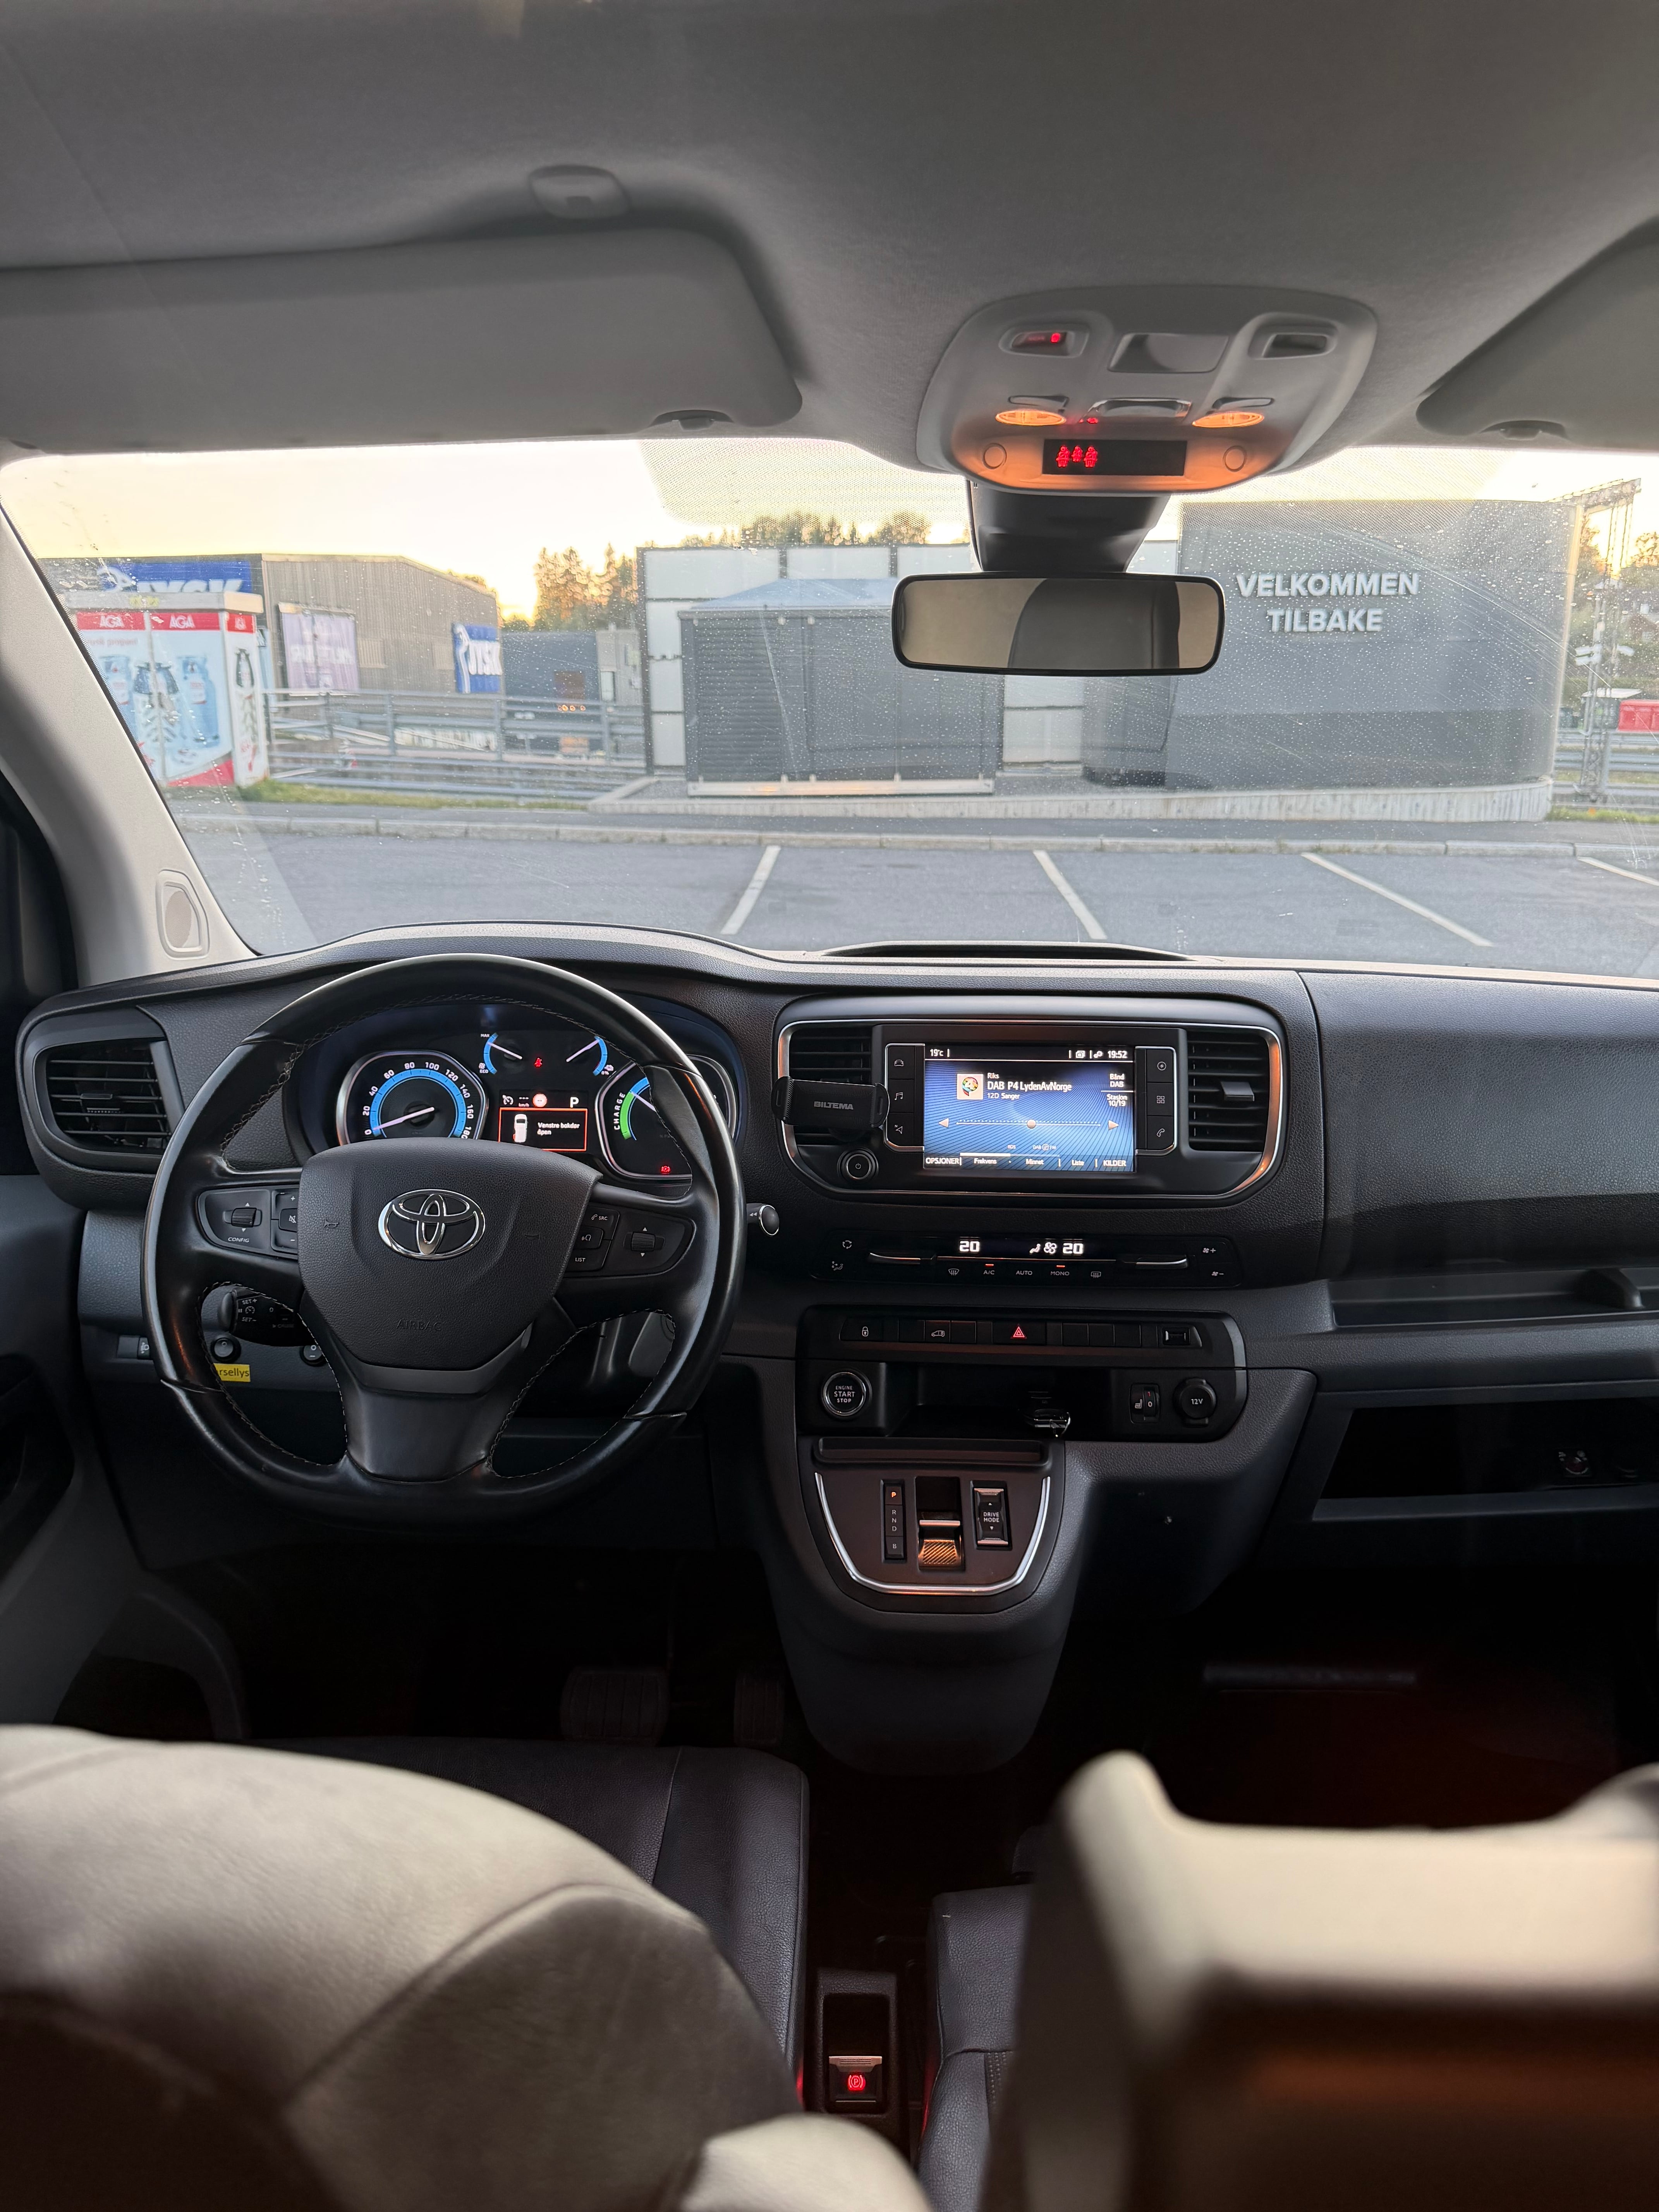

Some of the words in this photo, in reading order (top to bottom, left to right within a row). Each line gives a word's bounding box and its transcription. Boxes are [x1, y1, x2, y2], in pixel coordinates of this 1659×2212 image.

[1237, 572, 1419, 596] VELKOMMEN
[99, 615, 125, 628] AGA
[169, 614, 195, 629] AGA
[1267, 608, 1382, 632] TILBAKE
[1108, 1050, 1128, 1058] 19:52
[425, 1062, 440, 1070] 100
[383, 1069, 394, 1079] 60
[445, 1069, 459, 1082] 120
[369, 1086, 378, 1096] 40
[460, 1084, 471, 1098] 140
[987, 1081, 1005, 1090] DAB
[1008, 1082, 1019, 1090] P4
[1020, 1082, 1072, 1092] LydenAvNorge
[570, 1097, 579, 1108] P
[814, 1101, 854, 1110] BILTEMA
[362, 1106, 370, 1116] 20
[614, 1092, 625, 1130] CHARGE
[461, 1126, 472, 1139] 180
[959, 1241, 980, 1252] 20
[1063, 1243, 1083, 1254] 20
[216, 1368, 249, 1378] rsellys
